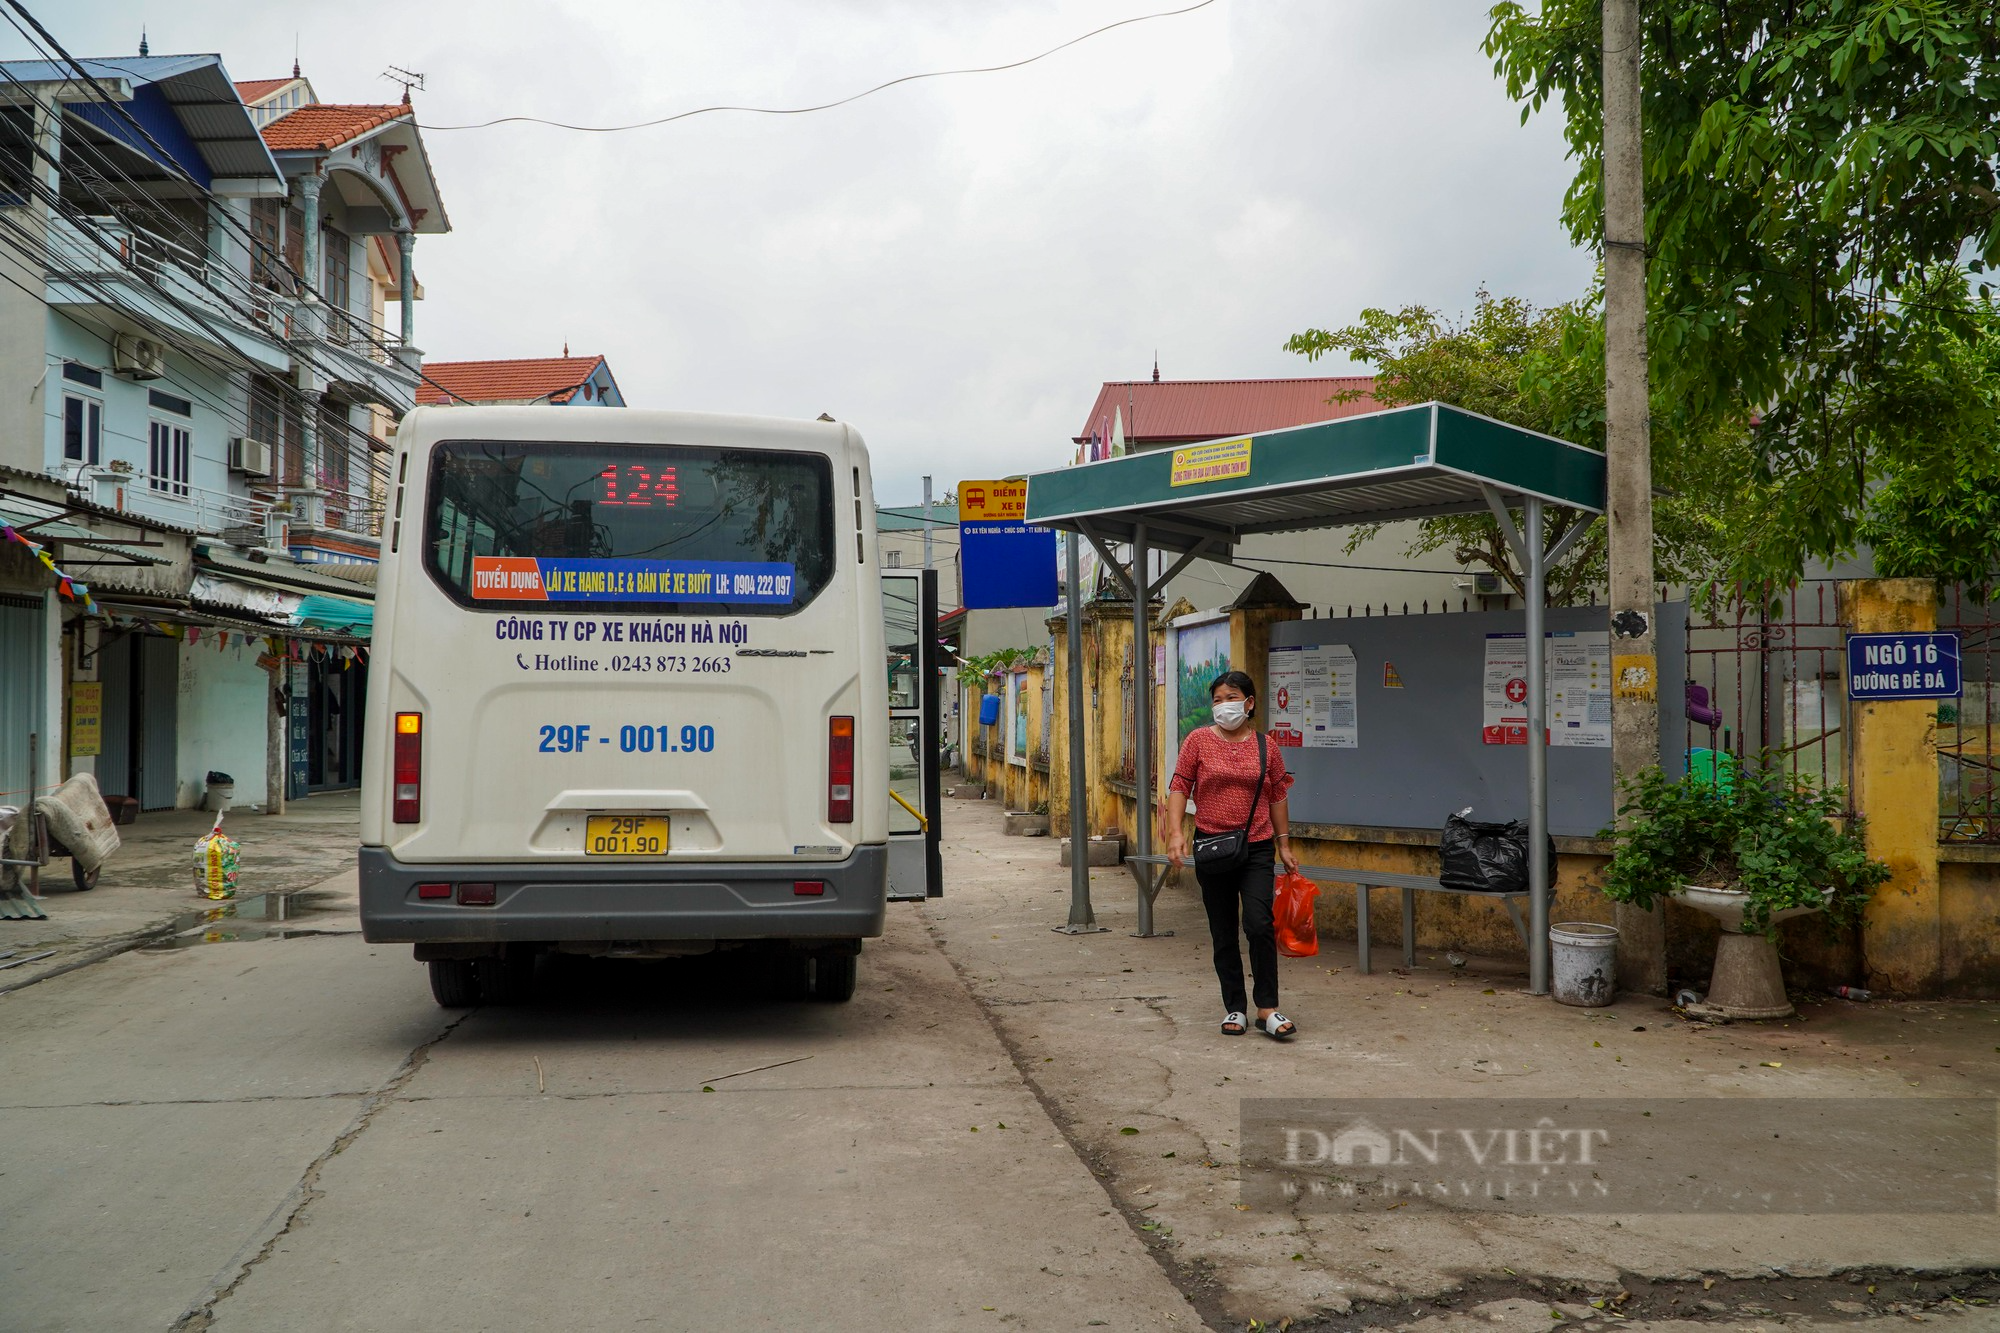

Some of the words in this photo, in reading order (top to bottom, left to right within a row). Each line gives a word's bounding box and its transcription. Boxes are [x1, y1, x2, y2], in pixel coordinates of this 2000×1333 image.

[599, 464, 679, 507] 124
[993, 486, 1016, 496] ĐIỂM
[476, 564, 508, 588] TUYỂN
[510, 571, 538, 592] DỤNG
[546, 566, 561, 592] LÁI
[564, 572, 576, 592] XE
[578, 572, 604, 597] HẠNG
[626, 572, 634, 593] &
[637, 568, 656, 593] BÁN
[659, 569, 670, 594] VÉ
[673, 574, 685, 594] XE
[688, 569, 711, 594] BUÝT
[716, 574, 730, 594] LH:
[734, 574, 755, 595] 0904
[757, 575, 773, 596] 222
[775, 575, 791, 596] 097
[496, 616, 543, 640] CÔNG
[549, 620, 568, 641] TY
[574, 621, 597, 642] CP
[602, 622, 623, 642] XE
[629, 619, 686, 643] KHÁCH
[692, 620, 714, 643] HÀ
[719, 620, 748, 647] NỘI
[534, 654, 599, 671] Hotline
[657, 656, 686, 672] 873
[692, 656, 731, 673] 2663
[1865, 640, 1907, 665] NGÕ
[1912, 644, 1938, 664] 16
[1853, 670, 1900, 690] ĐƯỜNG
[1902, 670, 1922, 689] ĐÊ
[1924, 669, 1945, 688] ĐÁ
[538, 725, 591, 753] 29F
[620, 725, 715, 753] 001.90
[610, 818, 647, 835] 29F
[595, 836, 659, 854] 001.90
